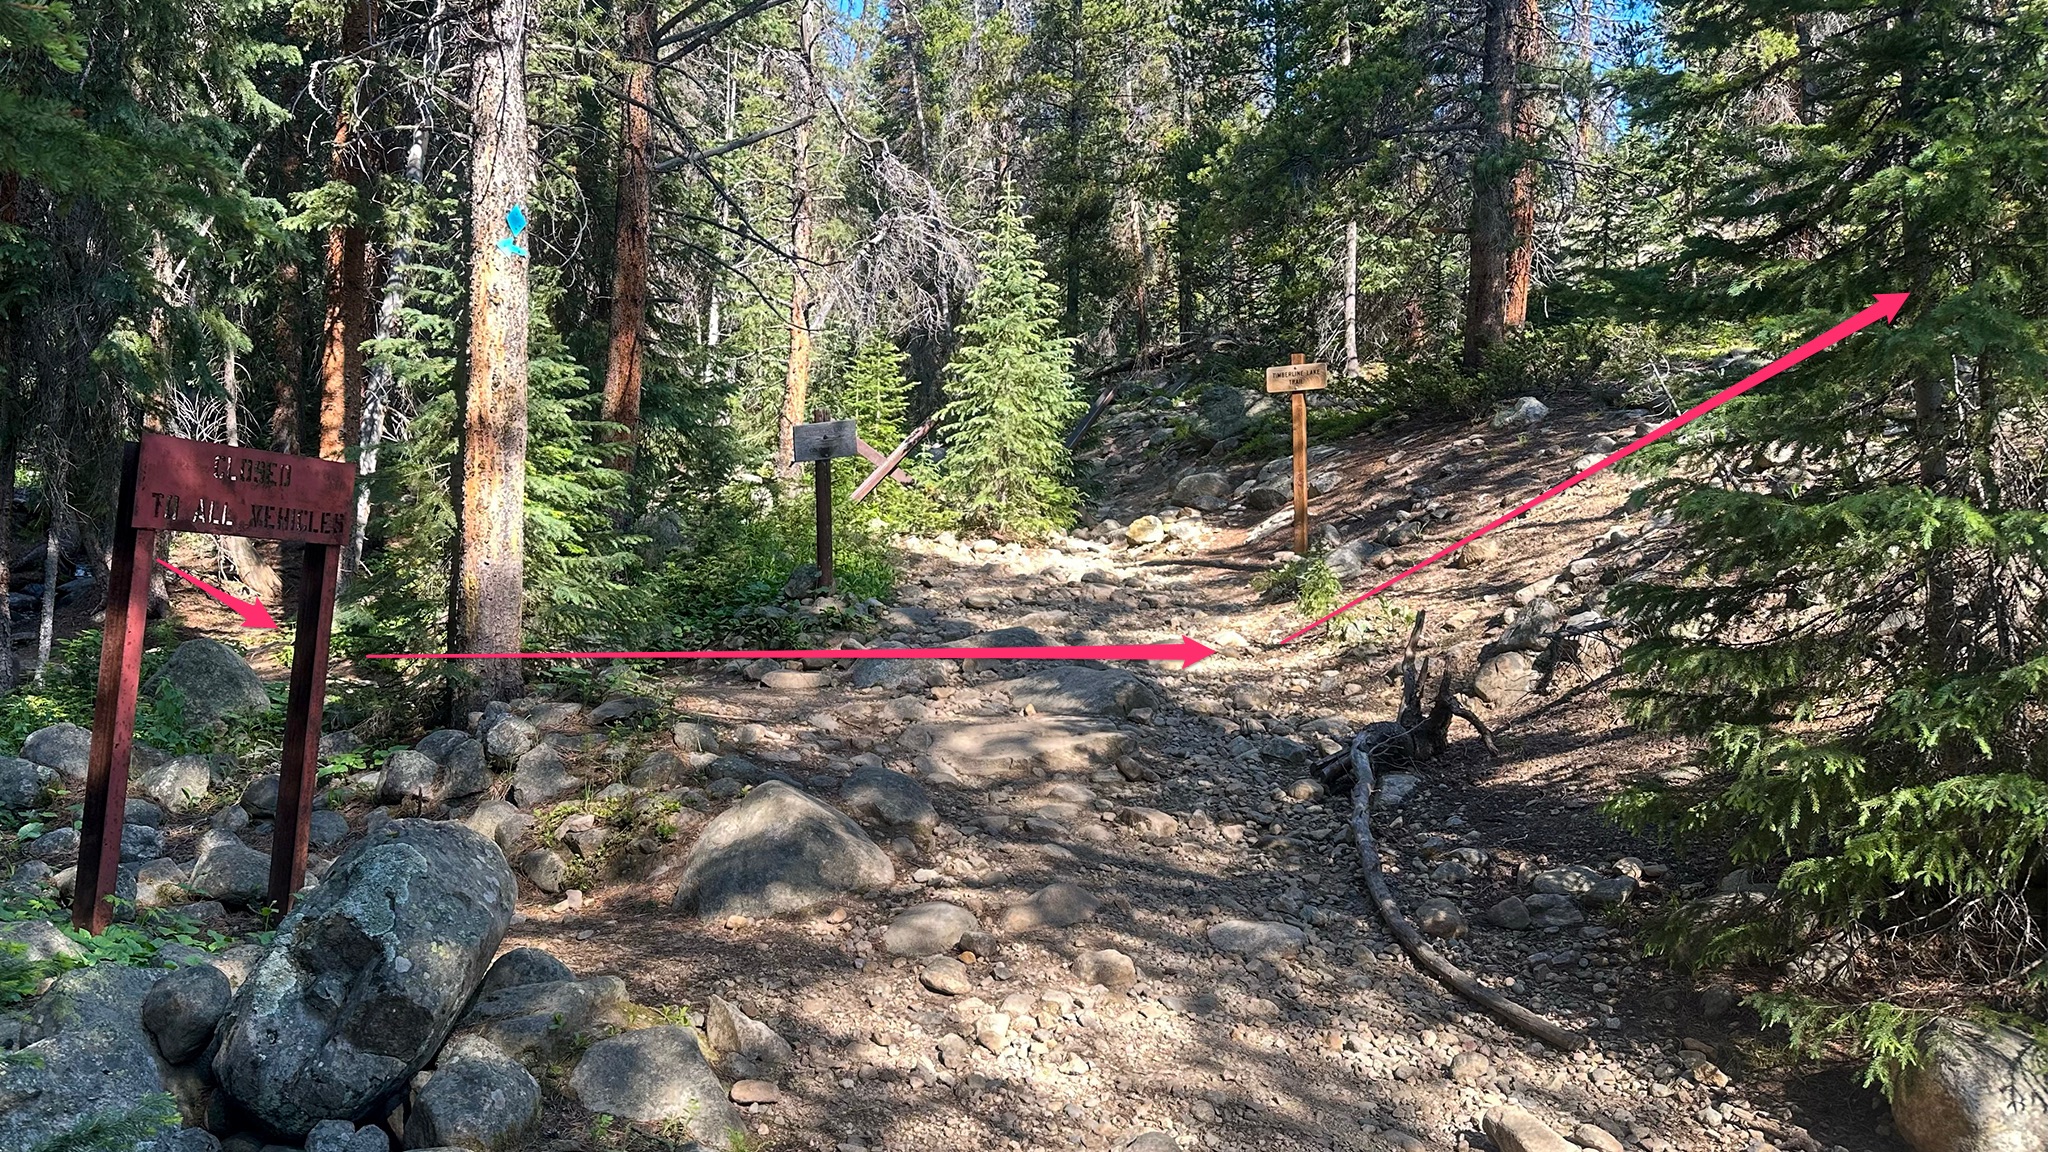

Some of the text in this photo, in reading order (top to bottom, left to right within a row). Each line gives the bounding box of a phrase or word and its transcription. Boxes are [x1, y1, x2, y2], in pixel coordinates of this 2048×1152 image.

[213, 455, 292, 487] CLOSED
[152, 492, 344, 534] TO ALL VEHICLES
